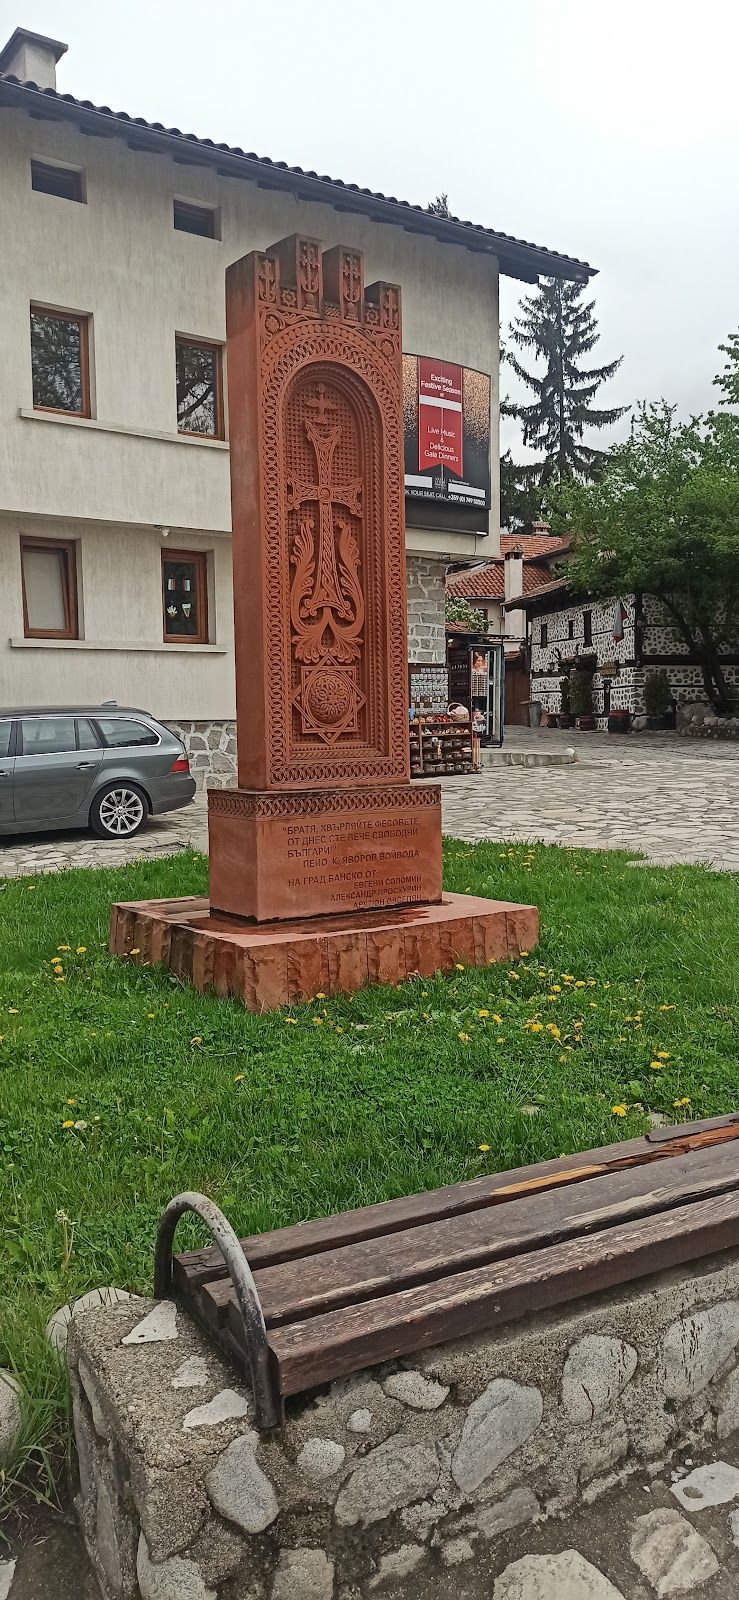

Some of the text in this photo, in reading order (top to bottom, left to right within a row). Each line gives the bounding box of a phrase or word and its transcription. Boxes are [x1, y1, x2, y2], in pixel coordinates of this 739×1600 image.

[430, 373, 453, 386] Exciting
[421, 380, 441, 390] Festive
[442, 385, 461, 395] Season
[427, 425, 456, 438] Live Music
[429, 442, 455, 453] Delicious
[424, 449, 459, 462] Gala Dinners
[320, 820, 373, 833] ХВЪРЛЯЙТЕ
[287, 828, 418, 847] ОТ ДНЕС СТЕ ВЕЧЕ СВОБОДНИ
[332, 857, 340, 866] К.
[341, 854, 377, 865] ЯВОРОВ
[379, 850, 420, 861] ВОЙВОДА
[288, 870, 379, 887] НА ГРАД БАНСКО ОТ:
[353, 875, 422, 889] ЕВГЕНИ СОЛОМИН
[330, 885, 422, 902] АЛЕКСАНДР ПРОСКУРИН
